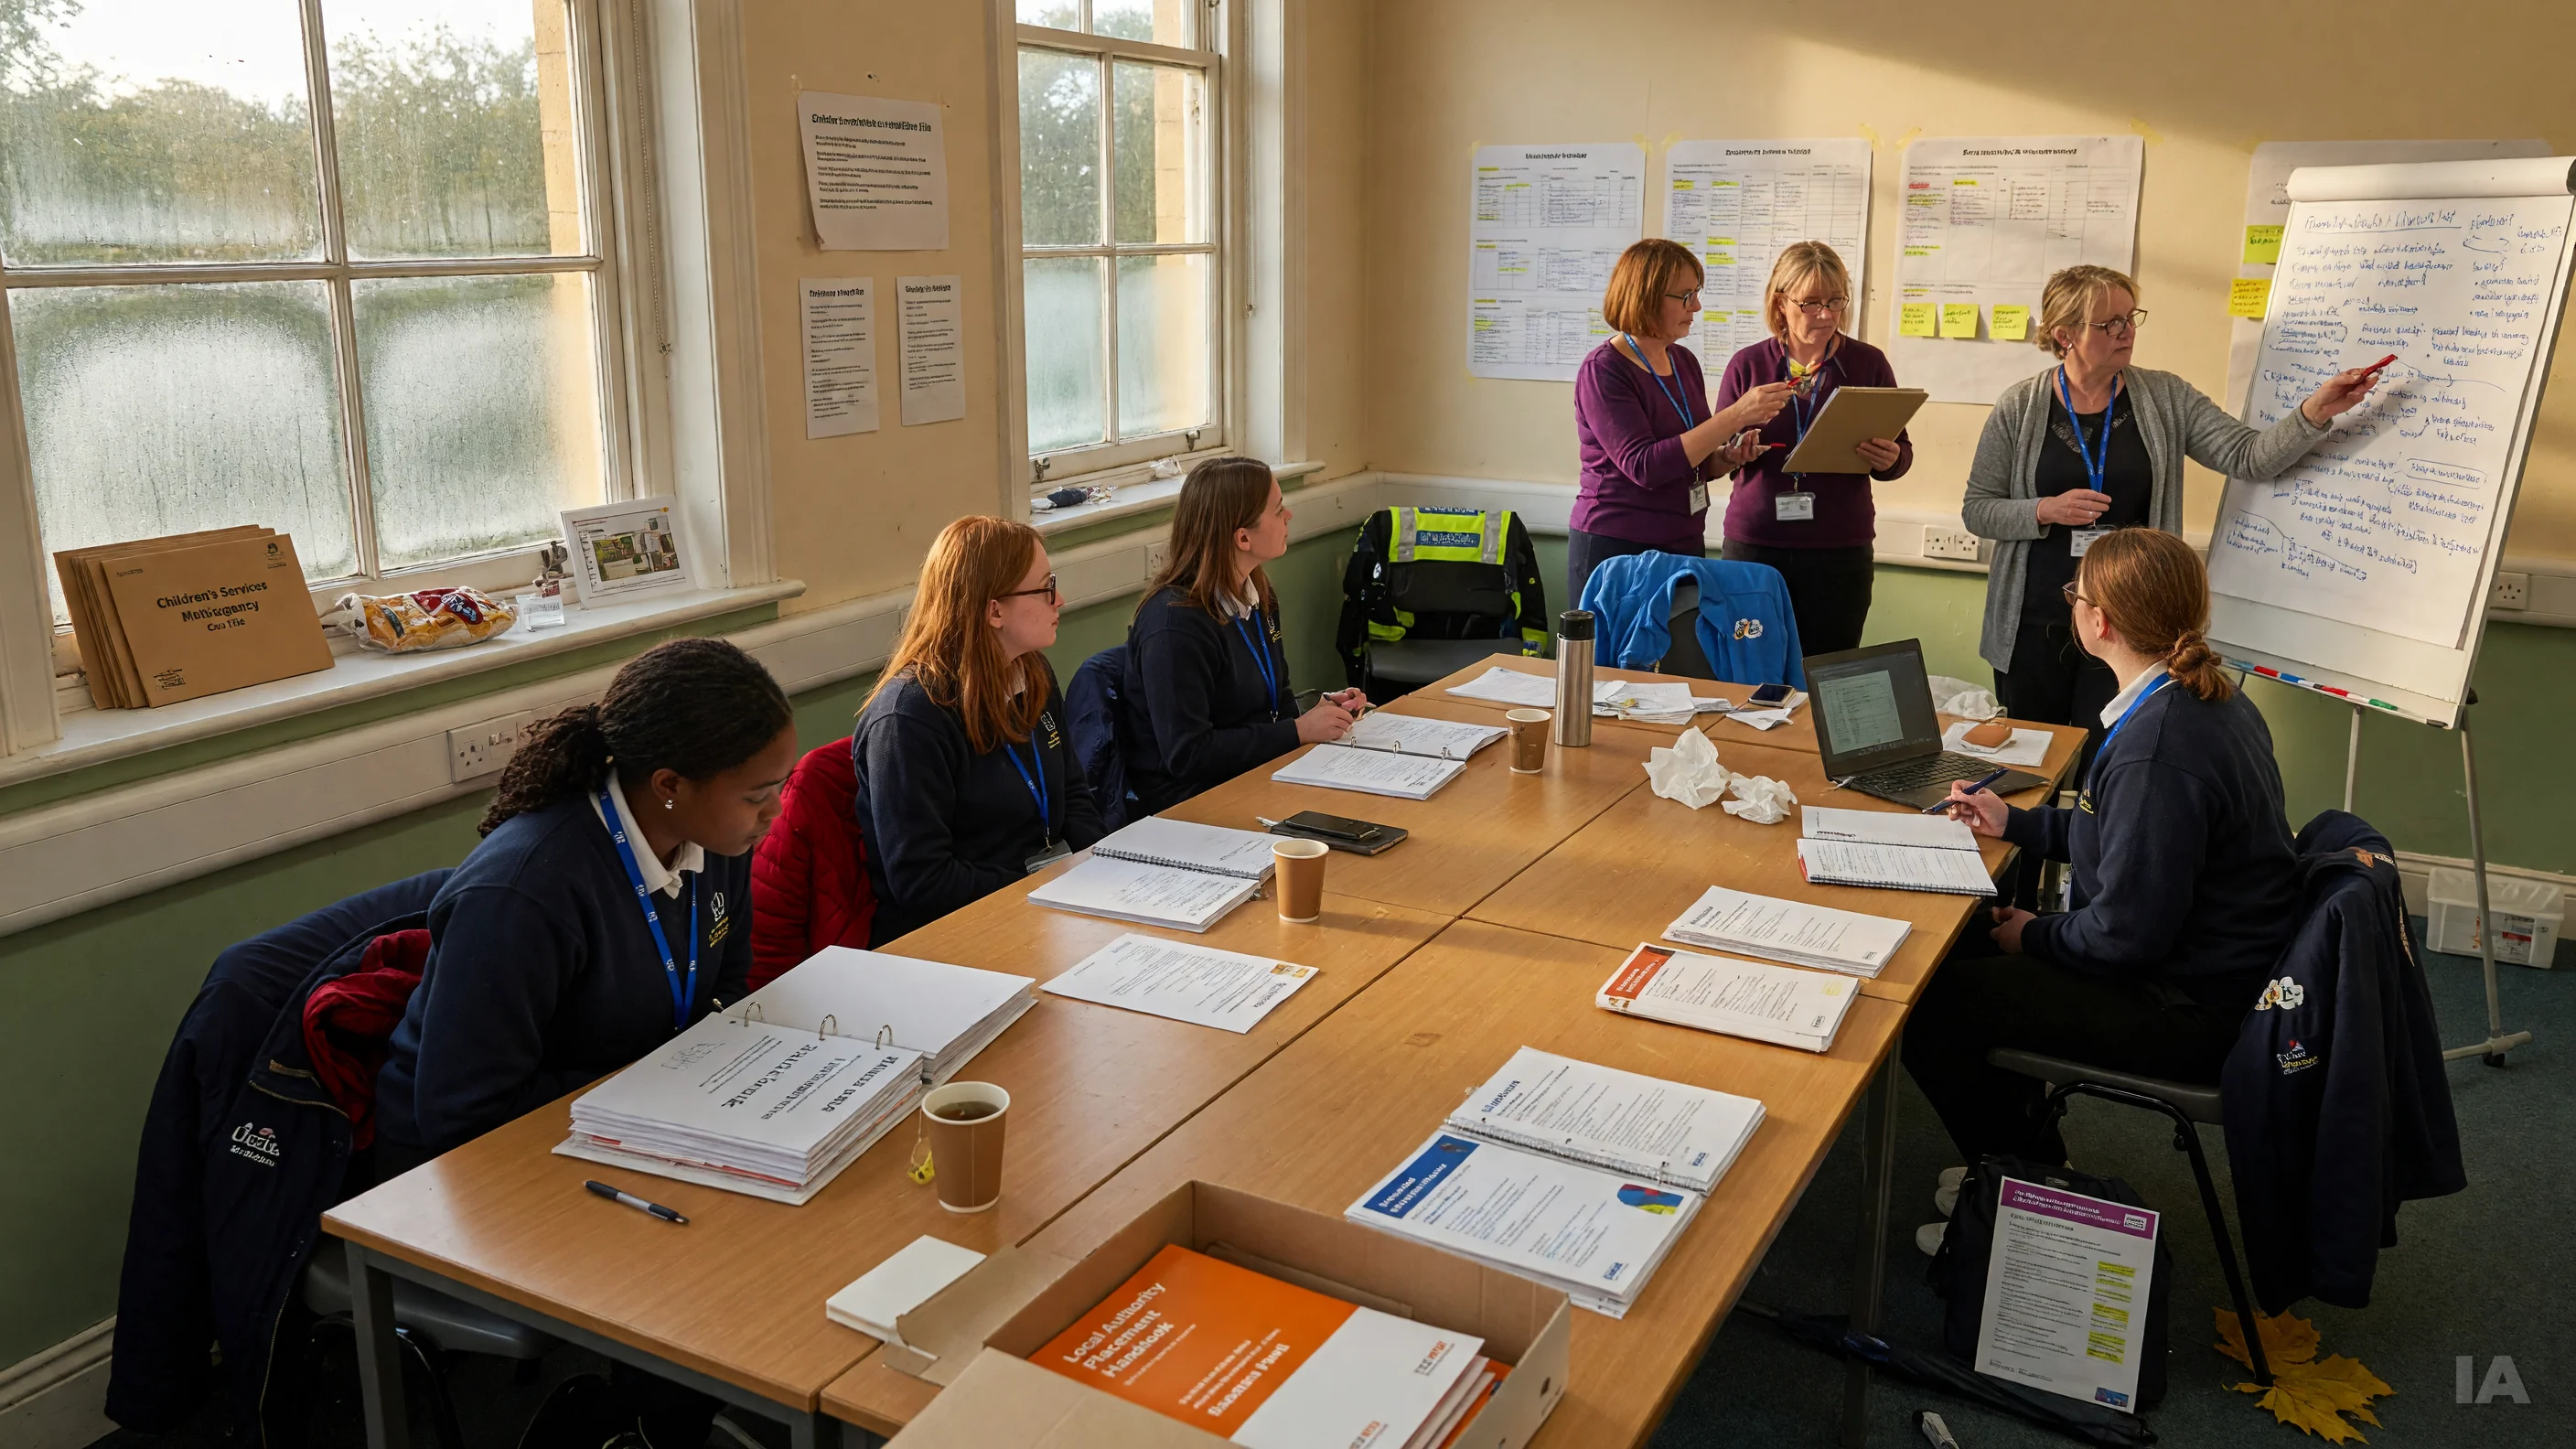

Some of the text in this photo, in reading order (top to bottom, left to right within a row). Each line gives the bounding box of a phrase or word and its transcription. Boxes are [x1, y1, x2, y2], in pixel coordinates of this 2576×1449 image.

[156, 589, 219, 609] Children's
[1062, 1331, 1106, 1363] Local
[1101, 1282, 1166, 1334] Authority
[1082, 1309, 1162, 1370] Placement
